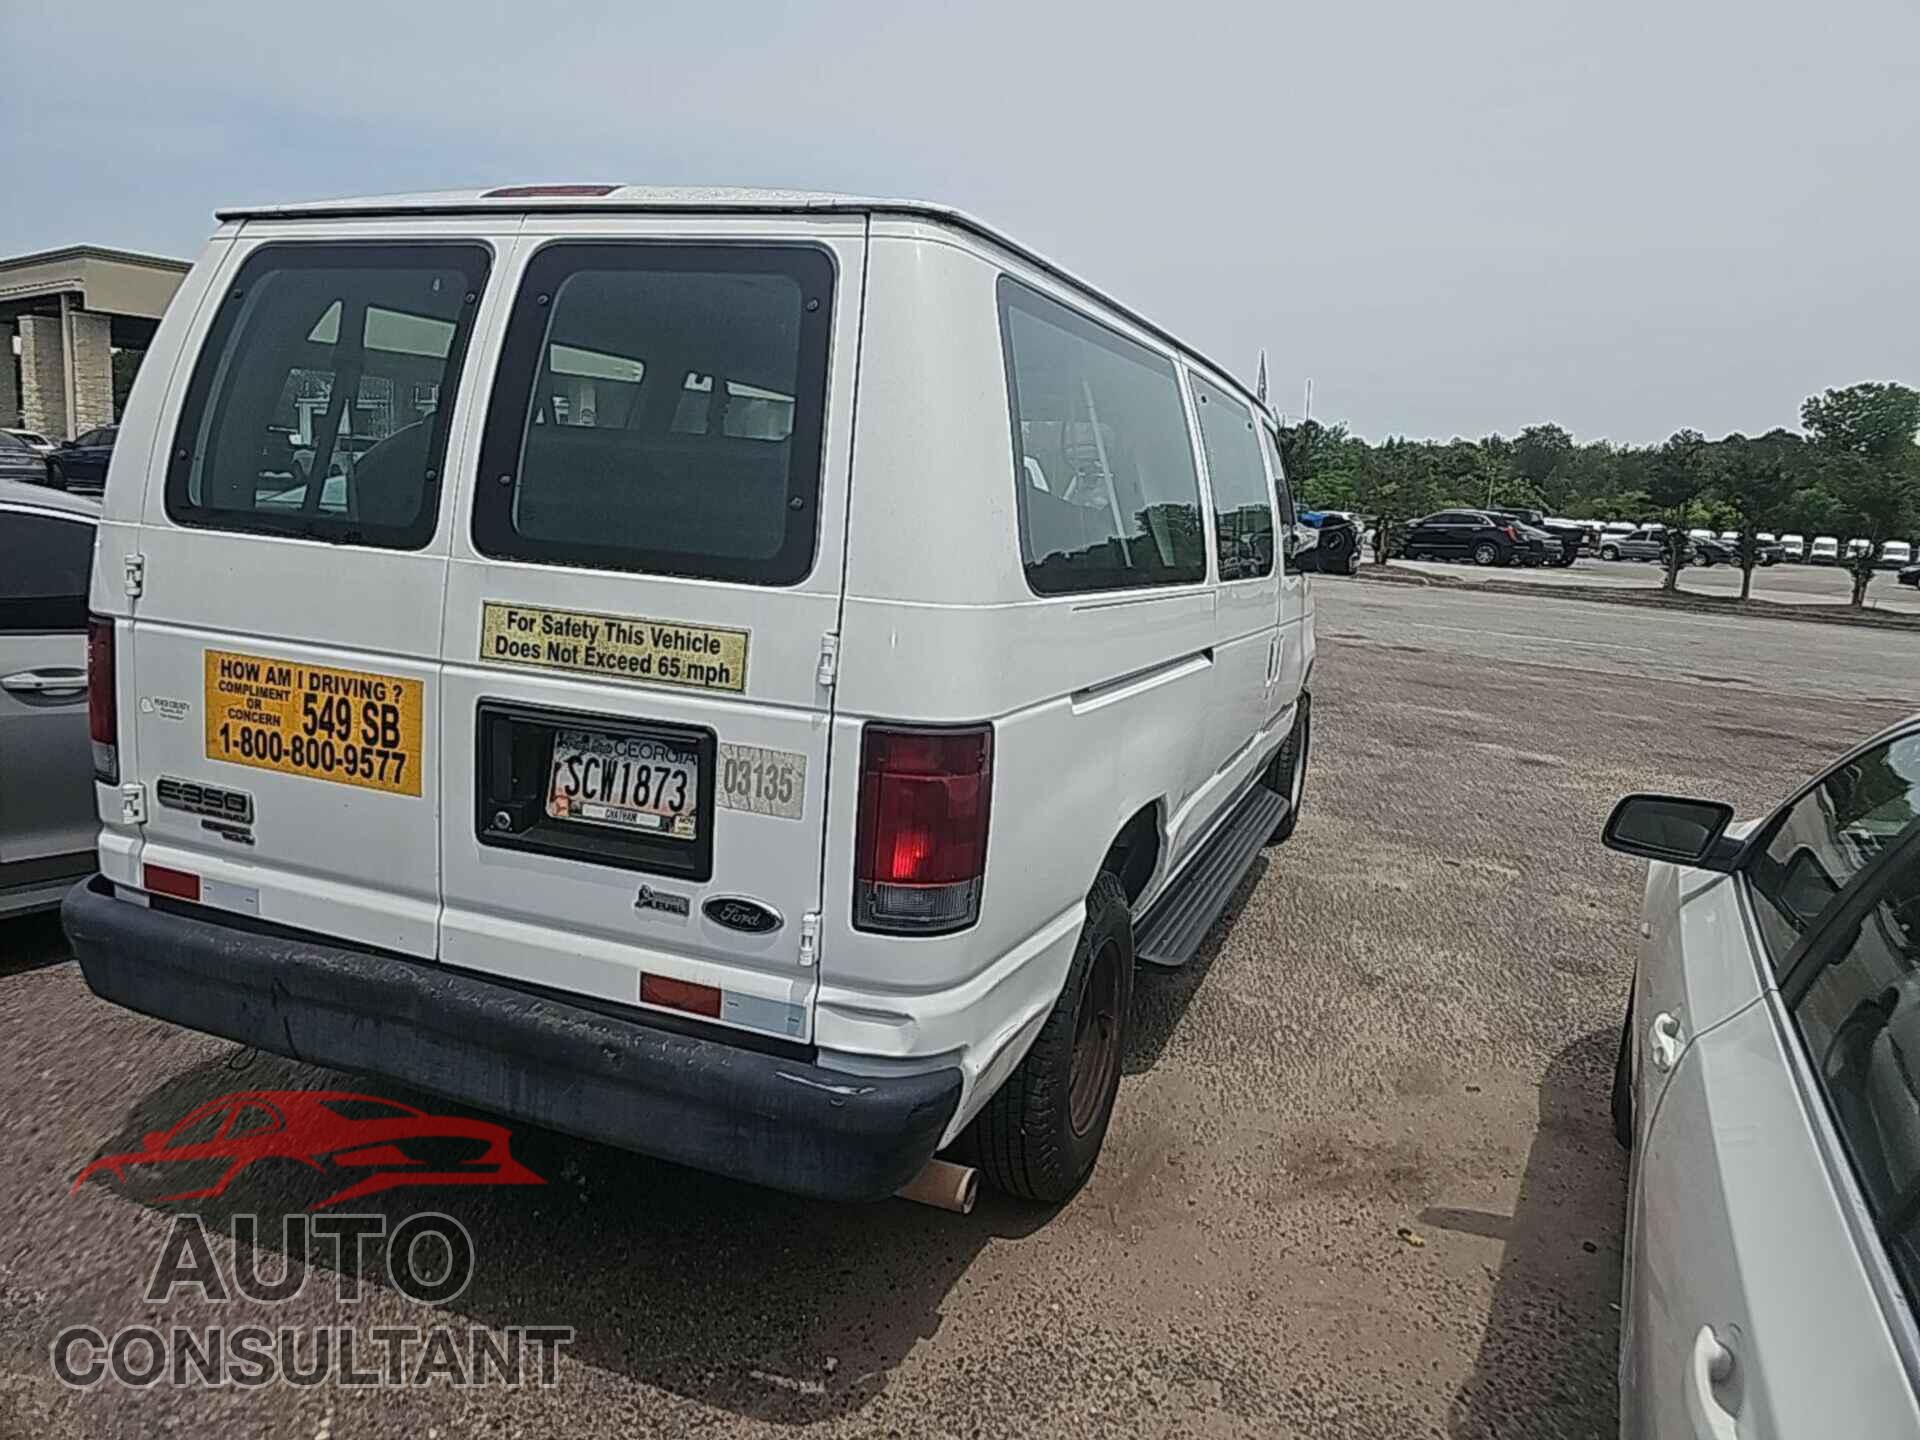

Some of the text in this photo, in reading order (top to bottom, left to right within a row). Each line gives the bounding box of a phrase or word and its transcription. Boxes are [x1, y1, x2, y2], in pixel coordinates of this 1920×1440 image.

[507, 611, 721, 655] For Safety This Vehicle
[220, 658, 403, 704] HOW AM I DRIVING ?
[495, 635, 730, 685] Does Not Exceed 65 mph
[218, 680, 291, 702] COMPLIMENT
[246, 698, 262, 710] OR
[228, 708, 281, 727] CONCERN
[302, 692, 400, 749] 549 SB
[219, 722, 406, 784] 1-800-800-9577
[564, 755, 688, 812] SCW1873
[724, 758, 793, 803] 03135
[719, 903, 761, 927] Ford
